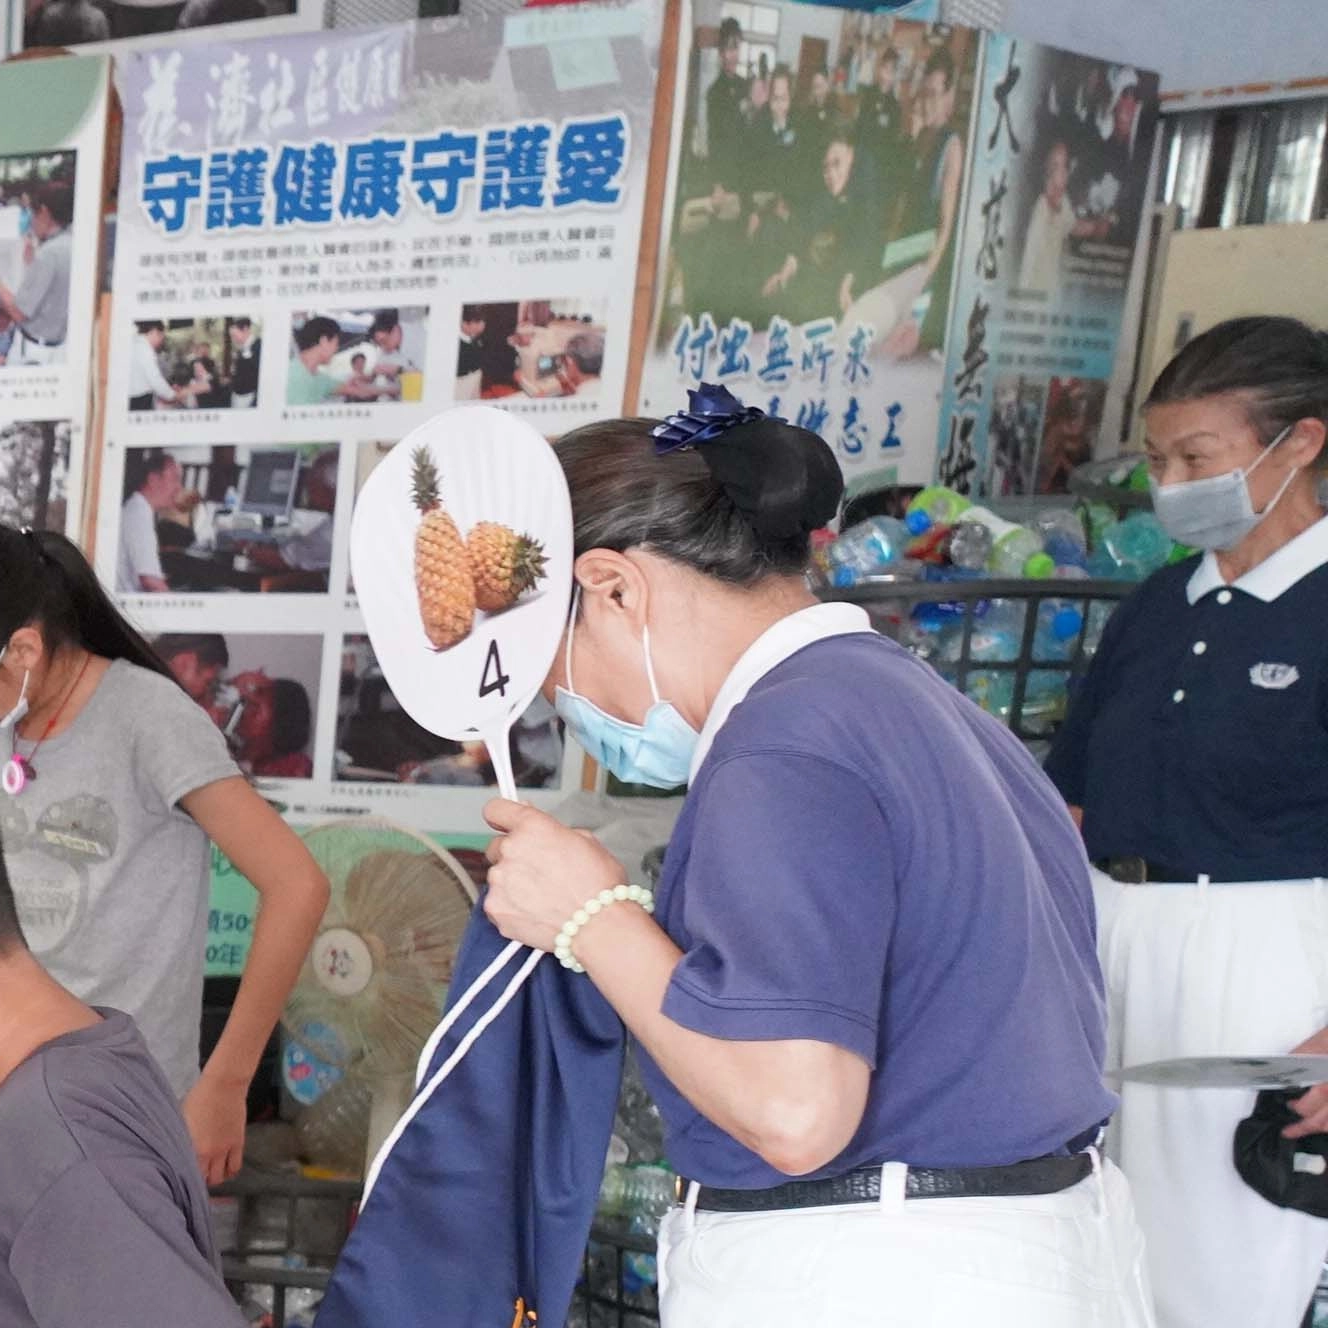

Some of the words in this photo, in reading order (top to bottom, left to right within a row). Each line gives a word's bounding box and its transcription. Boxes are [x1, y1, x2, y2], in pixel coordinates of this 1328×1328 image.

[142, 117, 625, 233] 守護健康守護愛
[674, 316, 874, 384] 付出無所求
[477, 638, 510, 698] 4
